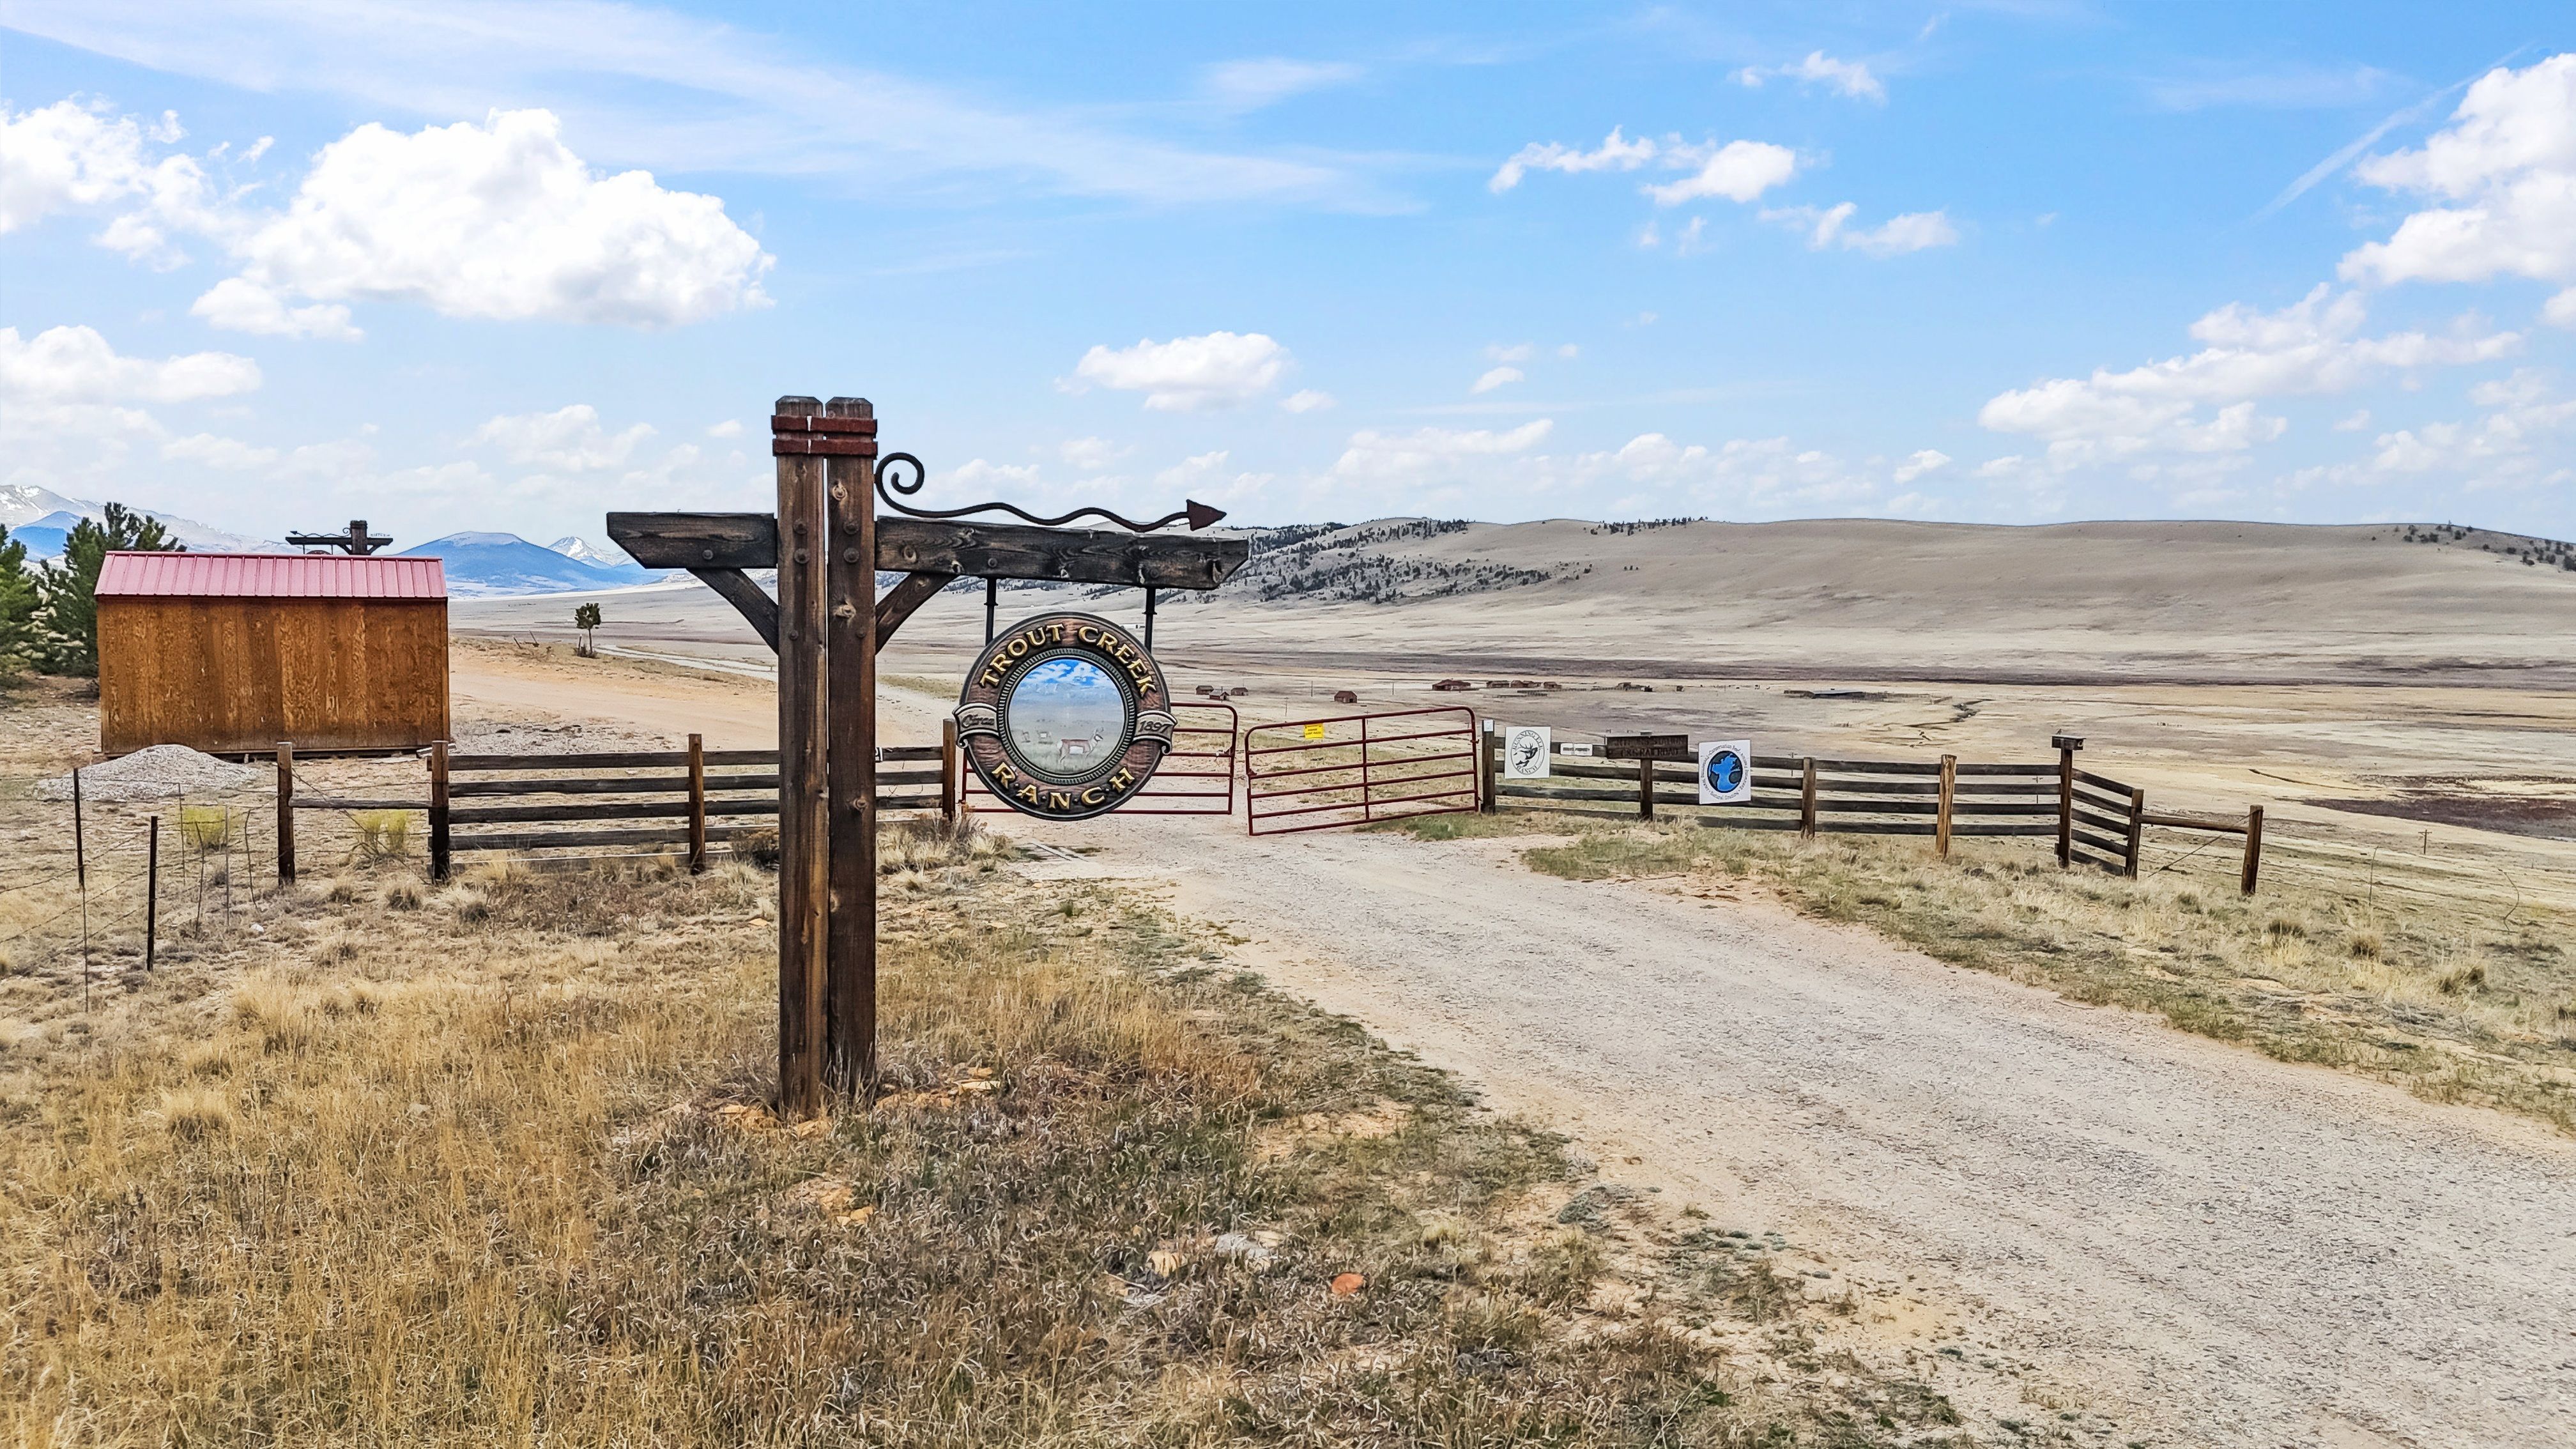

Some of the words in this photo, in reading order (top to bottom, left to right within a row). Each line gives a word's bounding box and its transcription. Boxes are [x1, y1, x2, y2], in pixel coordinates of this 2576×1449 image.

[979, 624, 1065, 688] TROUT
[1077, 626, 1156, 698] CREEK
[962, 714, 995, 728] Circa
[1139, 720, 1172, 733] 1897
